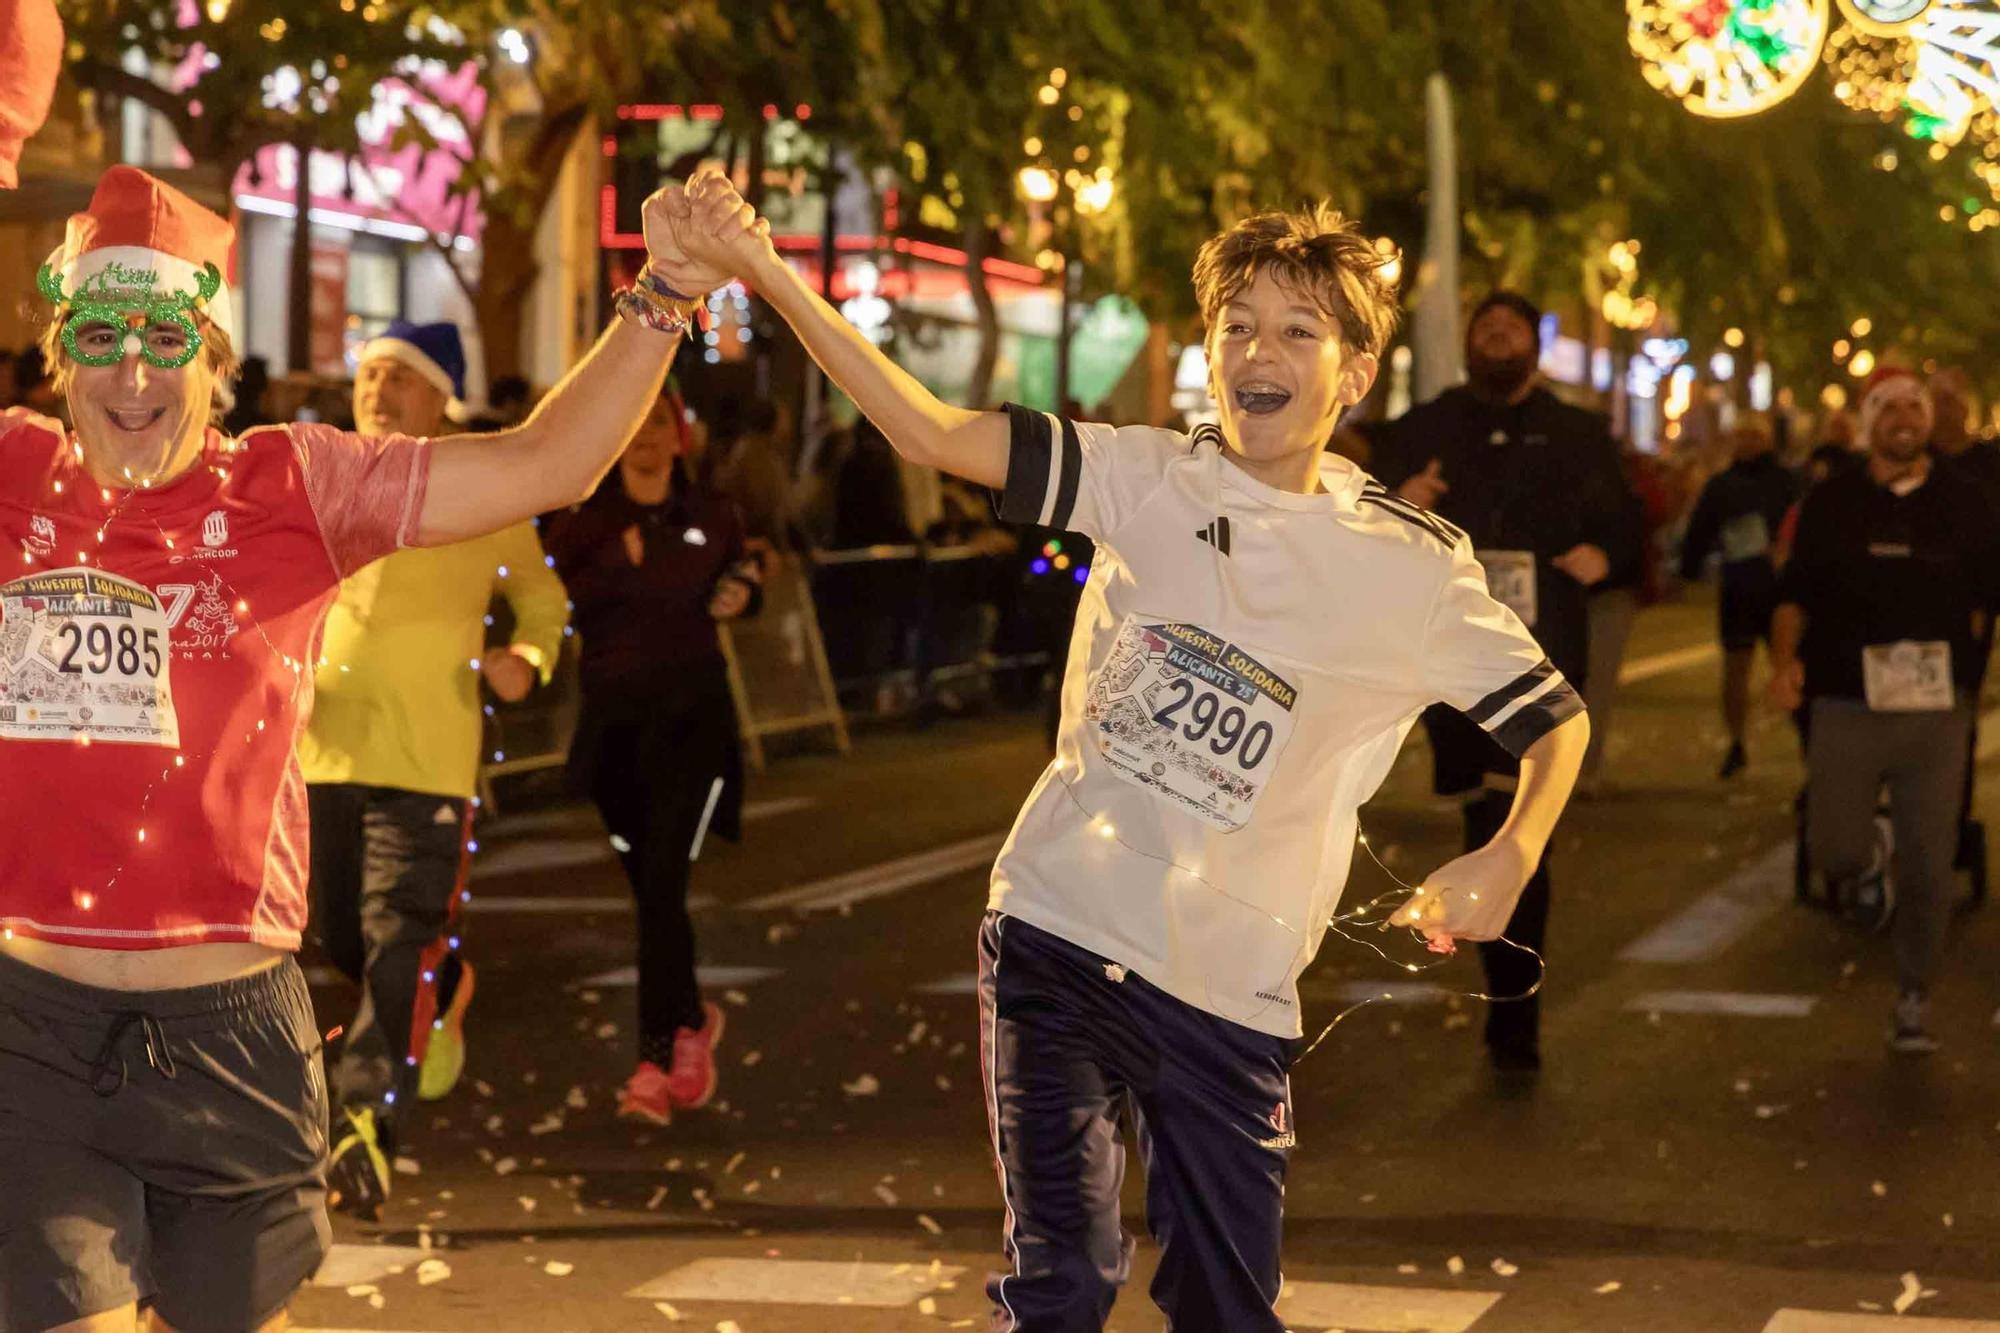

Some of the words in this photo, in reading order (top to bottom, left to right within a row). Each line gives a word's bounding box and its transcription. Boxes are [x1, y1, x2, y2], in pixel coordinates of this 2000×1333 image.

[30, 577, 85, 593] SILVESTRE
[95, 580, 154, 608] SOLIDARIA
[50, 599, 111, 614] ALICANTE
[58, 621, 161, 678] 2985
[1162, 624, 1221, 657] SILVESTRE
[1227, 652, 1293, 705] SOLIDARIA
[1168, 650, 1234, 690] ALICANTE
[1152, 678, 1273, 770] 2990
